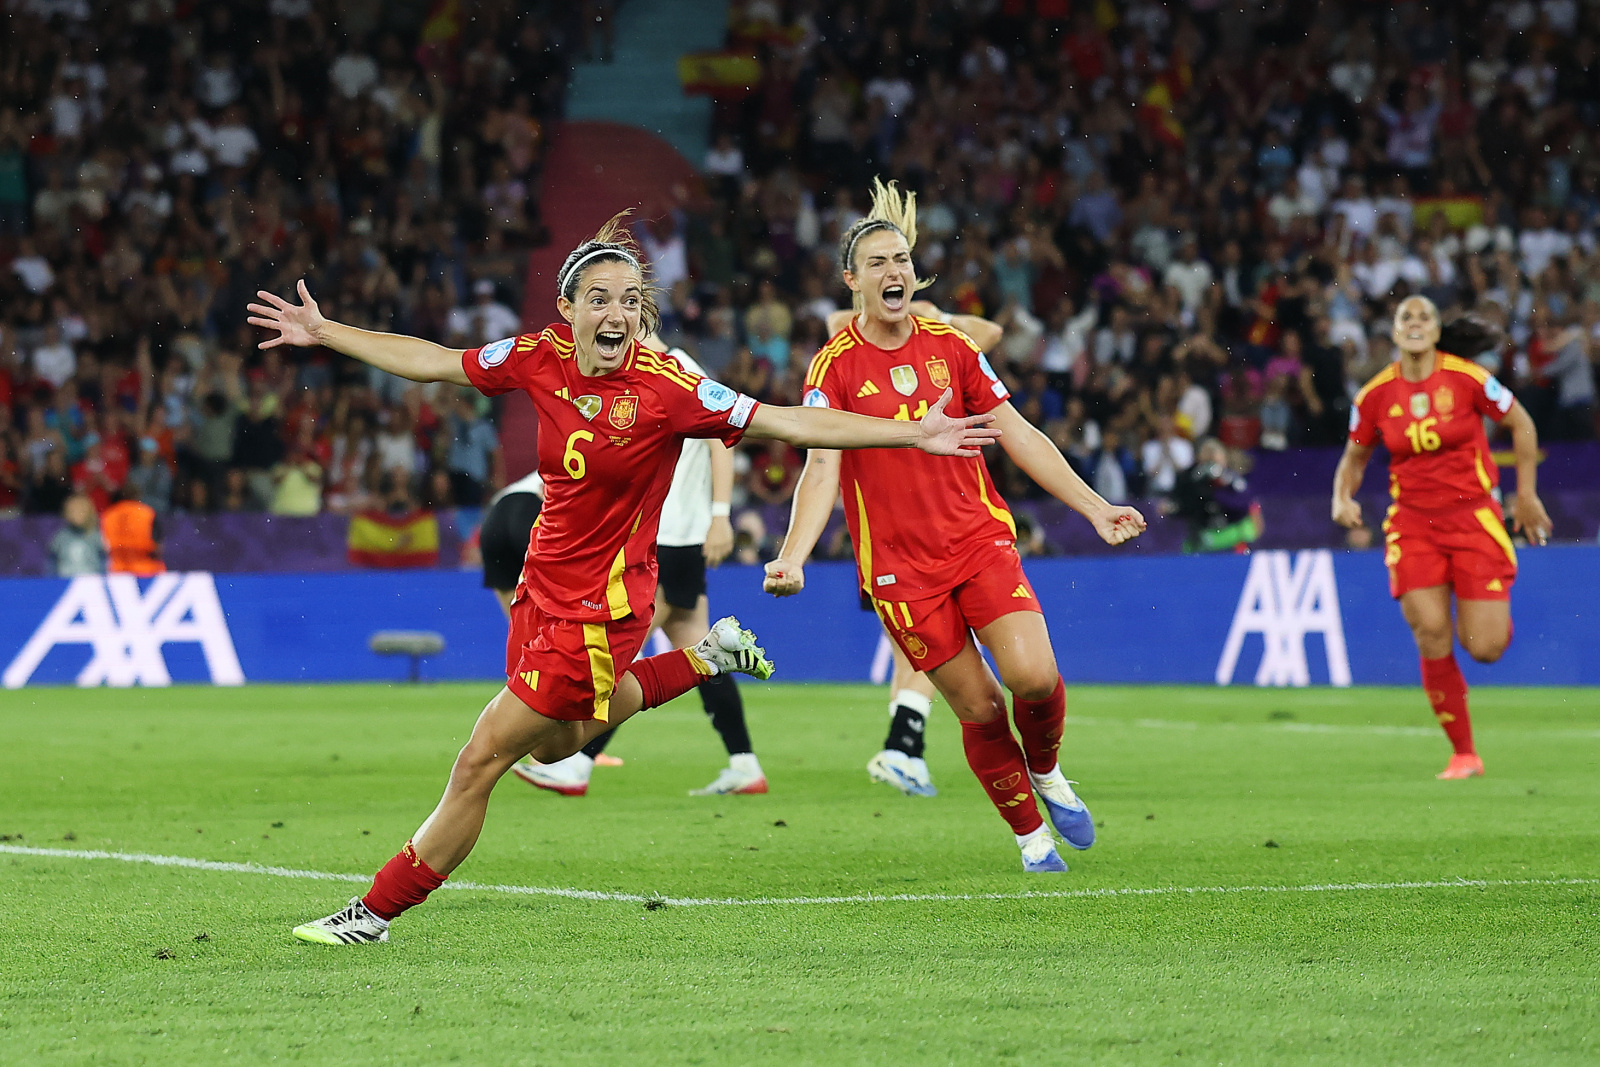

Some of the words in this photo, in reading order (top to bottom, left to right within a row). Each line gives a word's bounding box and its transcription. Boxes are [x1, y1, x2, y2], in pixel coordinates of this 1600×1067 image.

[563, 429, 595, 480] 6
[1404, 416, 1442, 454] 16
[1, 571, 246, 689] AXA
[1215, 550, 1353, 687] AXA
